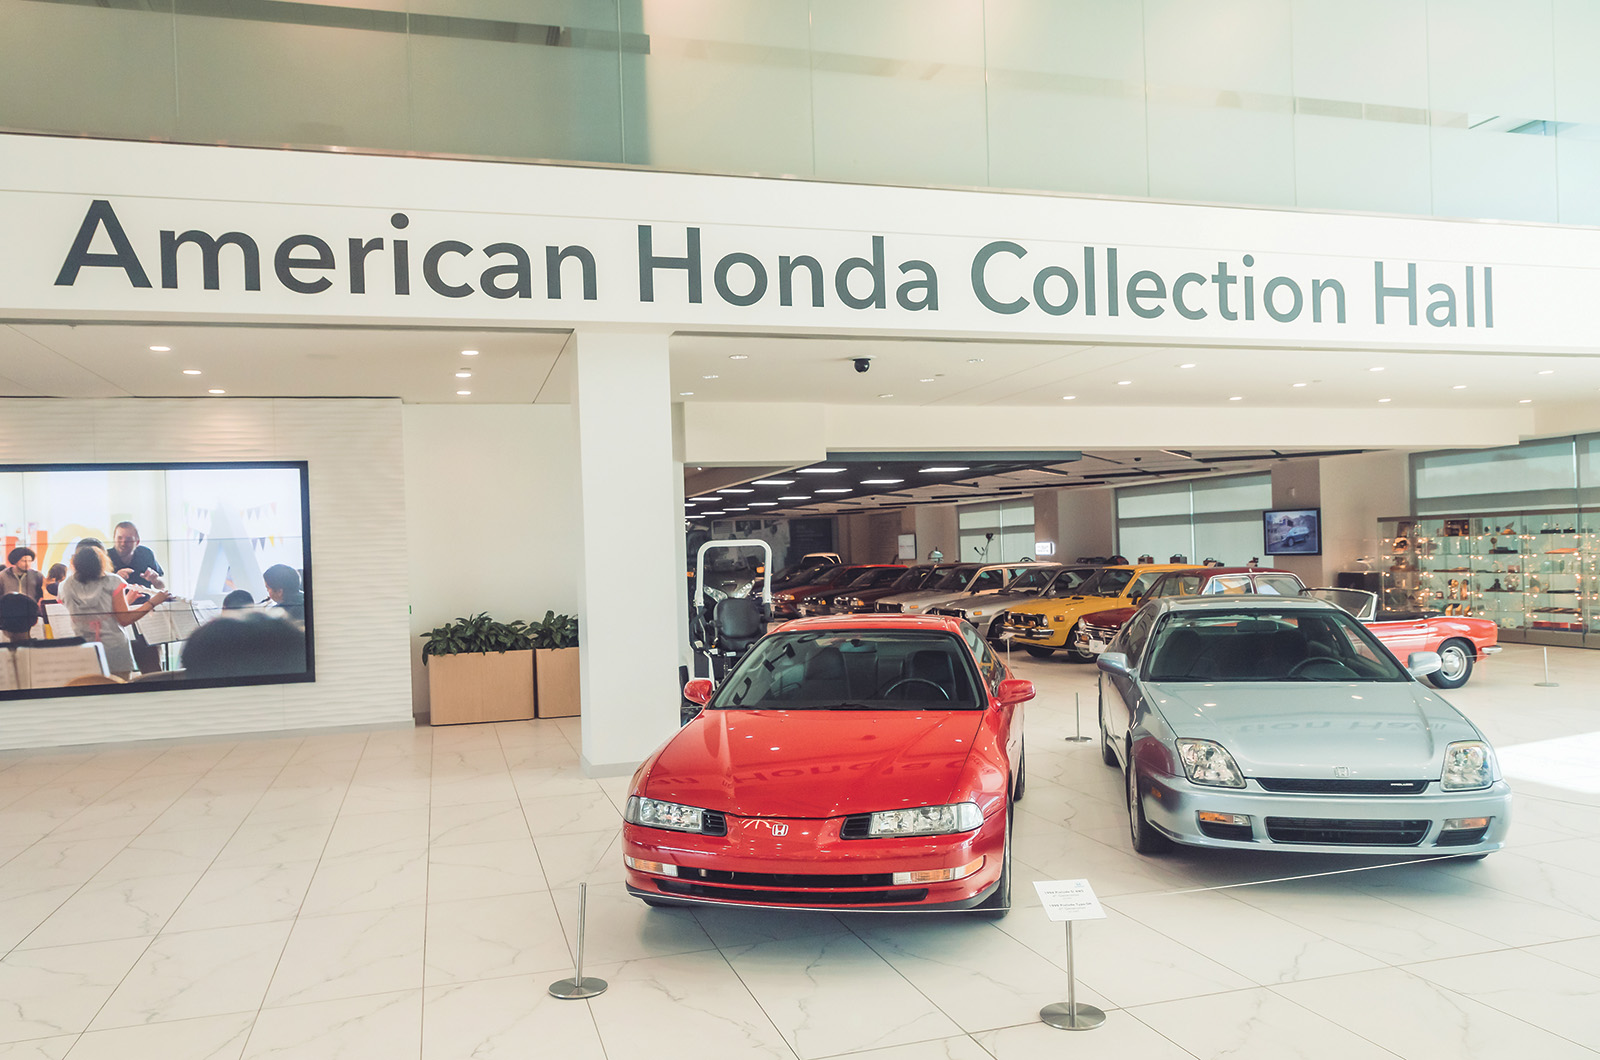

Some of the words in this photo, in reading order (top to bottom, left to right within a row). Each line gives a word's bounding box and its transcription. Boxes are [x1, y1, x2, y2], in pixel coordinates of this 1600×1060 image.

[54, 200, 598, 301] American
[638, 225, 939, 312] Honda
[971, 241, 1346, 324] Collection
[1375, 261, 1494, 328] Hall
